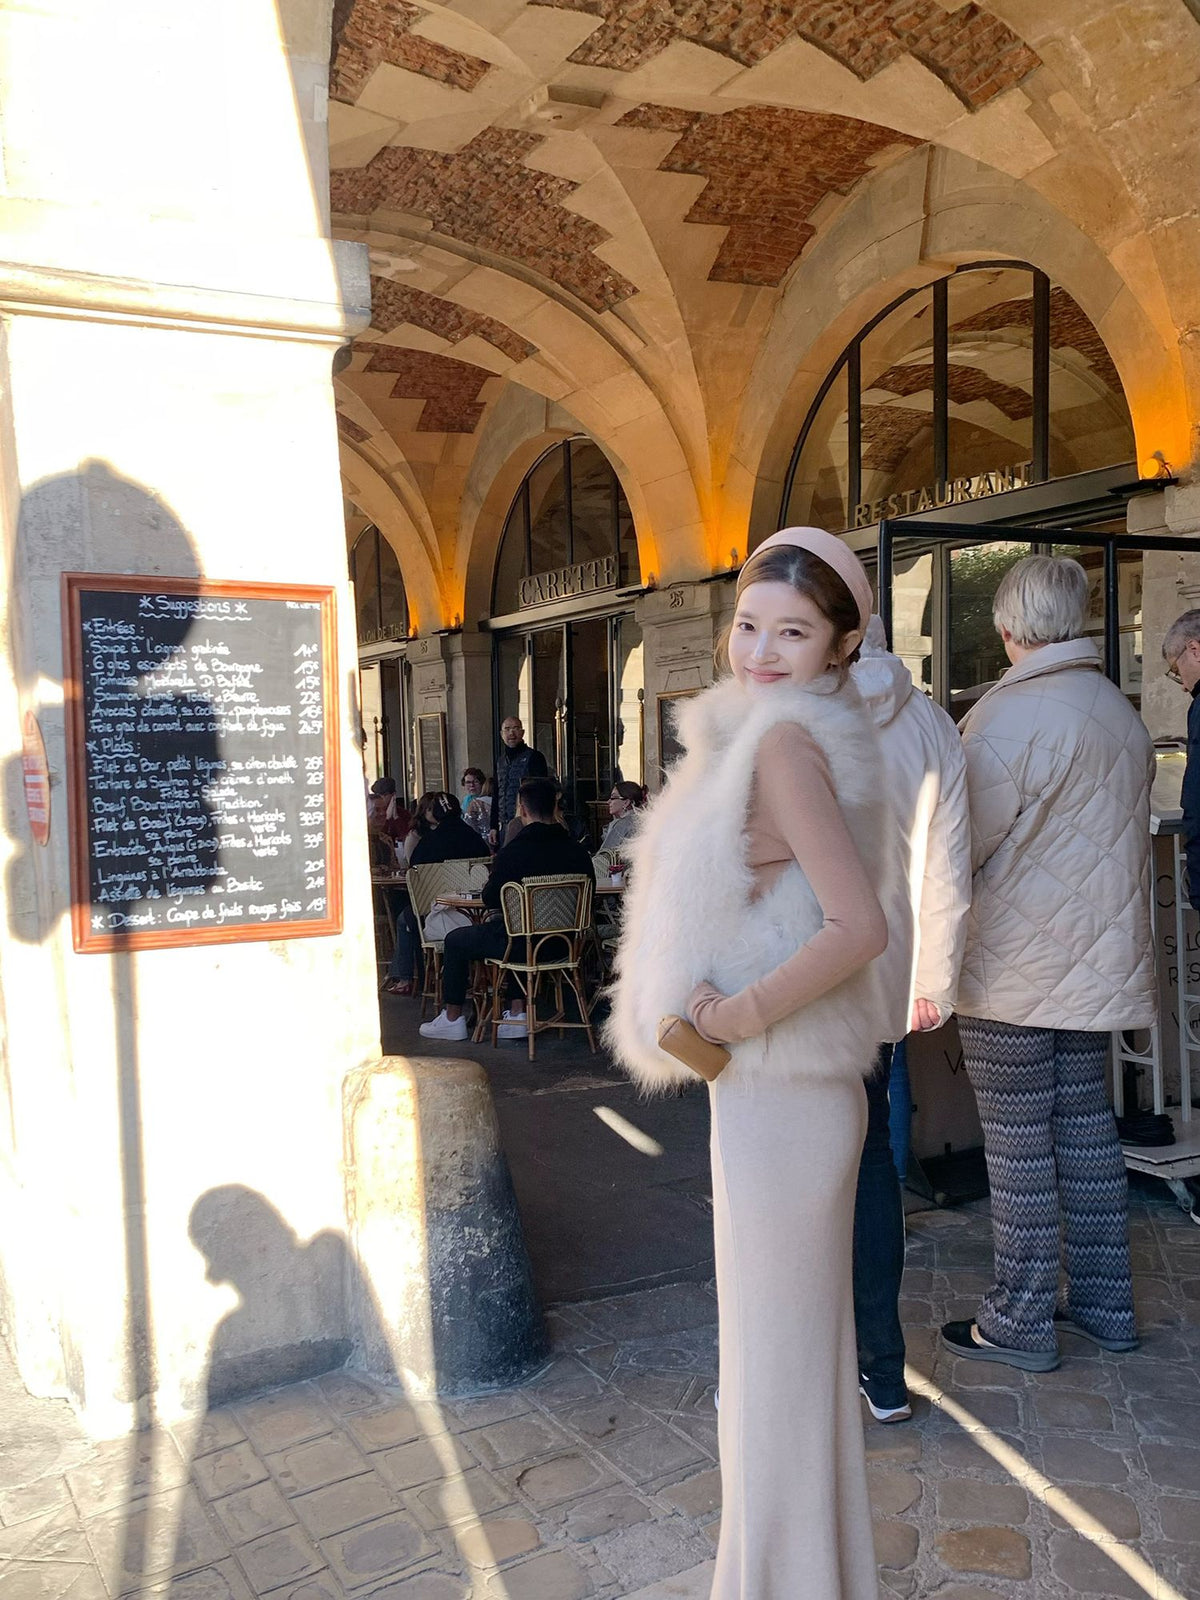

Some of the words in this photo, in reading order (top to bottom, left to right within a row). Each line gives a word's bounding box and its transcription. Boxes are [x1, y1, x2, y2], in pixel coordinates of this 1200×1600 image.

[855, 460, 1033, 527] RESTAURANT
[519, 555, 617, 606] CARETTE
[155, 595, 231, 619] Suggestions
[90, 641, 128, 661] Soupe
[92, 655, 104, 670] 6
[194, 658, 209, 671] de
[90, 671, 139, 687] Tomates
[93, 687, 141, 702] Saumon
[90, 719, 114, 732] Foie
[137, 718, 151, 732] de
[93, 759, 120, 773] Filet
[124, 759, 138, 773] de
[134, 776, 147, 789] de
[149, 775, 189, 789] Saumon
[93, 817, 119, 833] Filet
[122, 817, 137, 830] de
[146, 884, 162, 899] de
[202, 904, 217, 919] de
